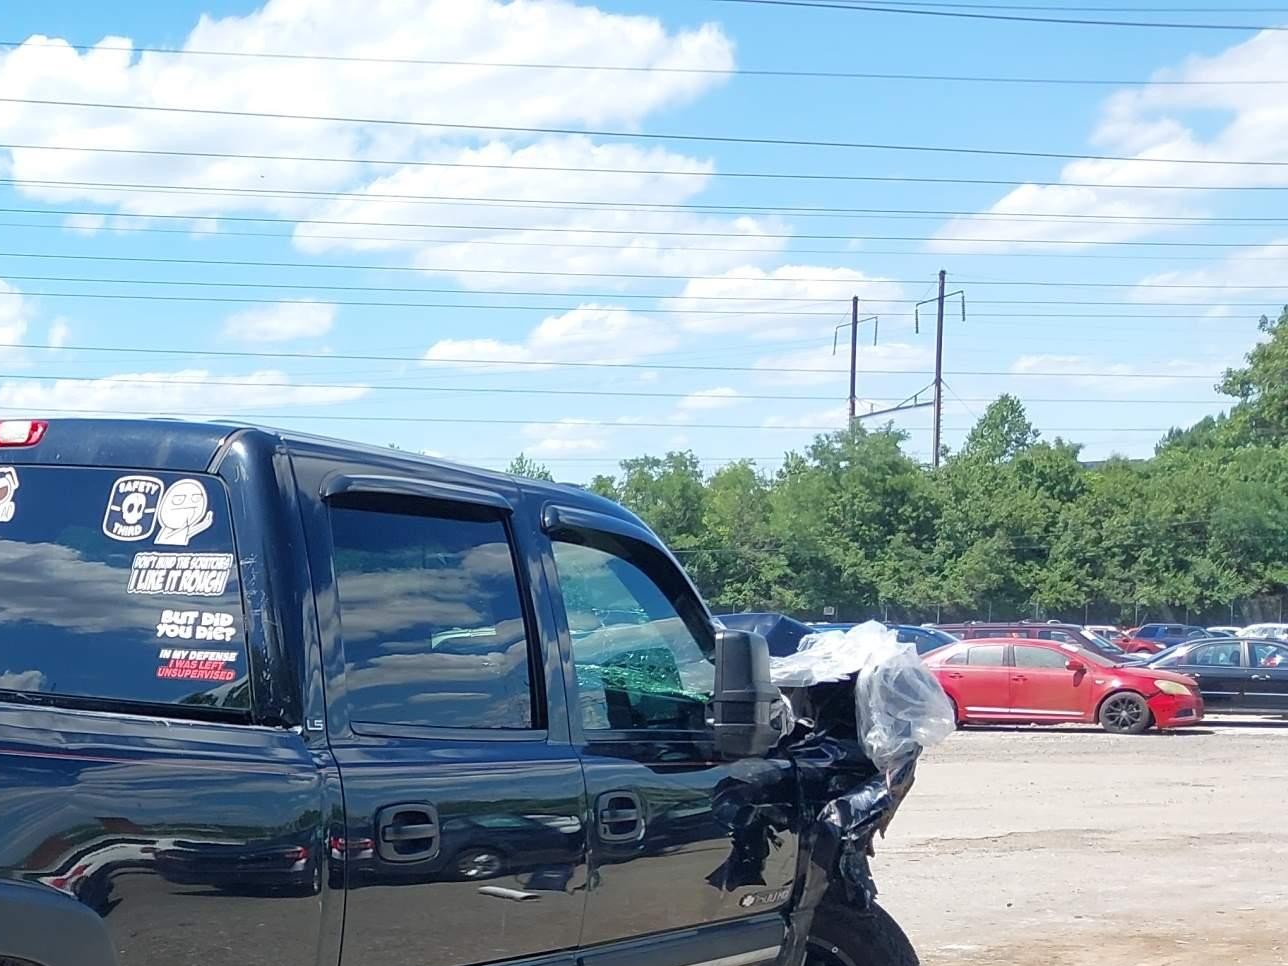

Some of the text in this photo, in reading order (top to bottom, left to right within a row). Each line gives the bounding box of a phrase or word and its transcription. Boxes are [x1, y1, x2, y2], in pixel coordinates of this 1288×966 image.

[119, 481, 159, 495] SAFETY
[113, 522, 143, 537] THIRD
[129, 569, 227, 593] I LIKE IT ROUGH
[161, 610, 233, 627] BUT DID
[156, 623, 192, 639] YOU
[159, 649, 238, 662] IN MY DEFENSE
[168, 659, 225, 671] I WAS LEFT
[157, 667, 235, 680] UNSUPERVISED
[306, 719, 323, 731] LS
